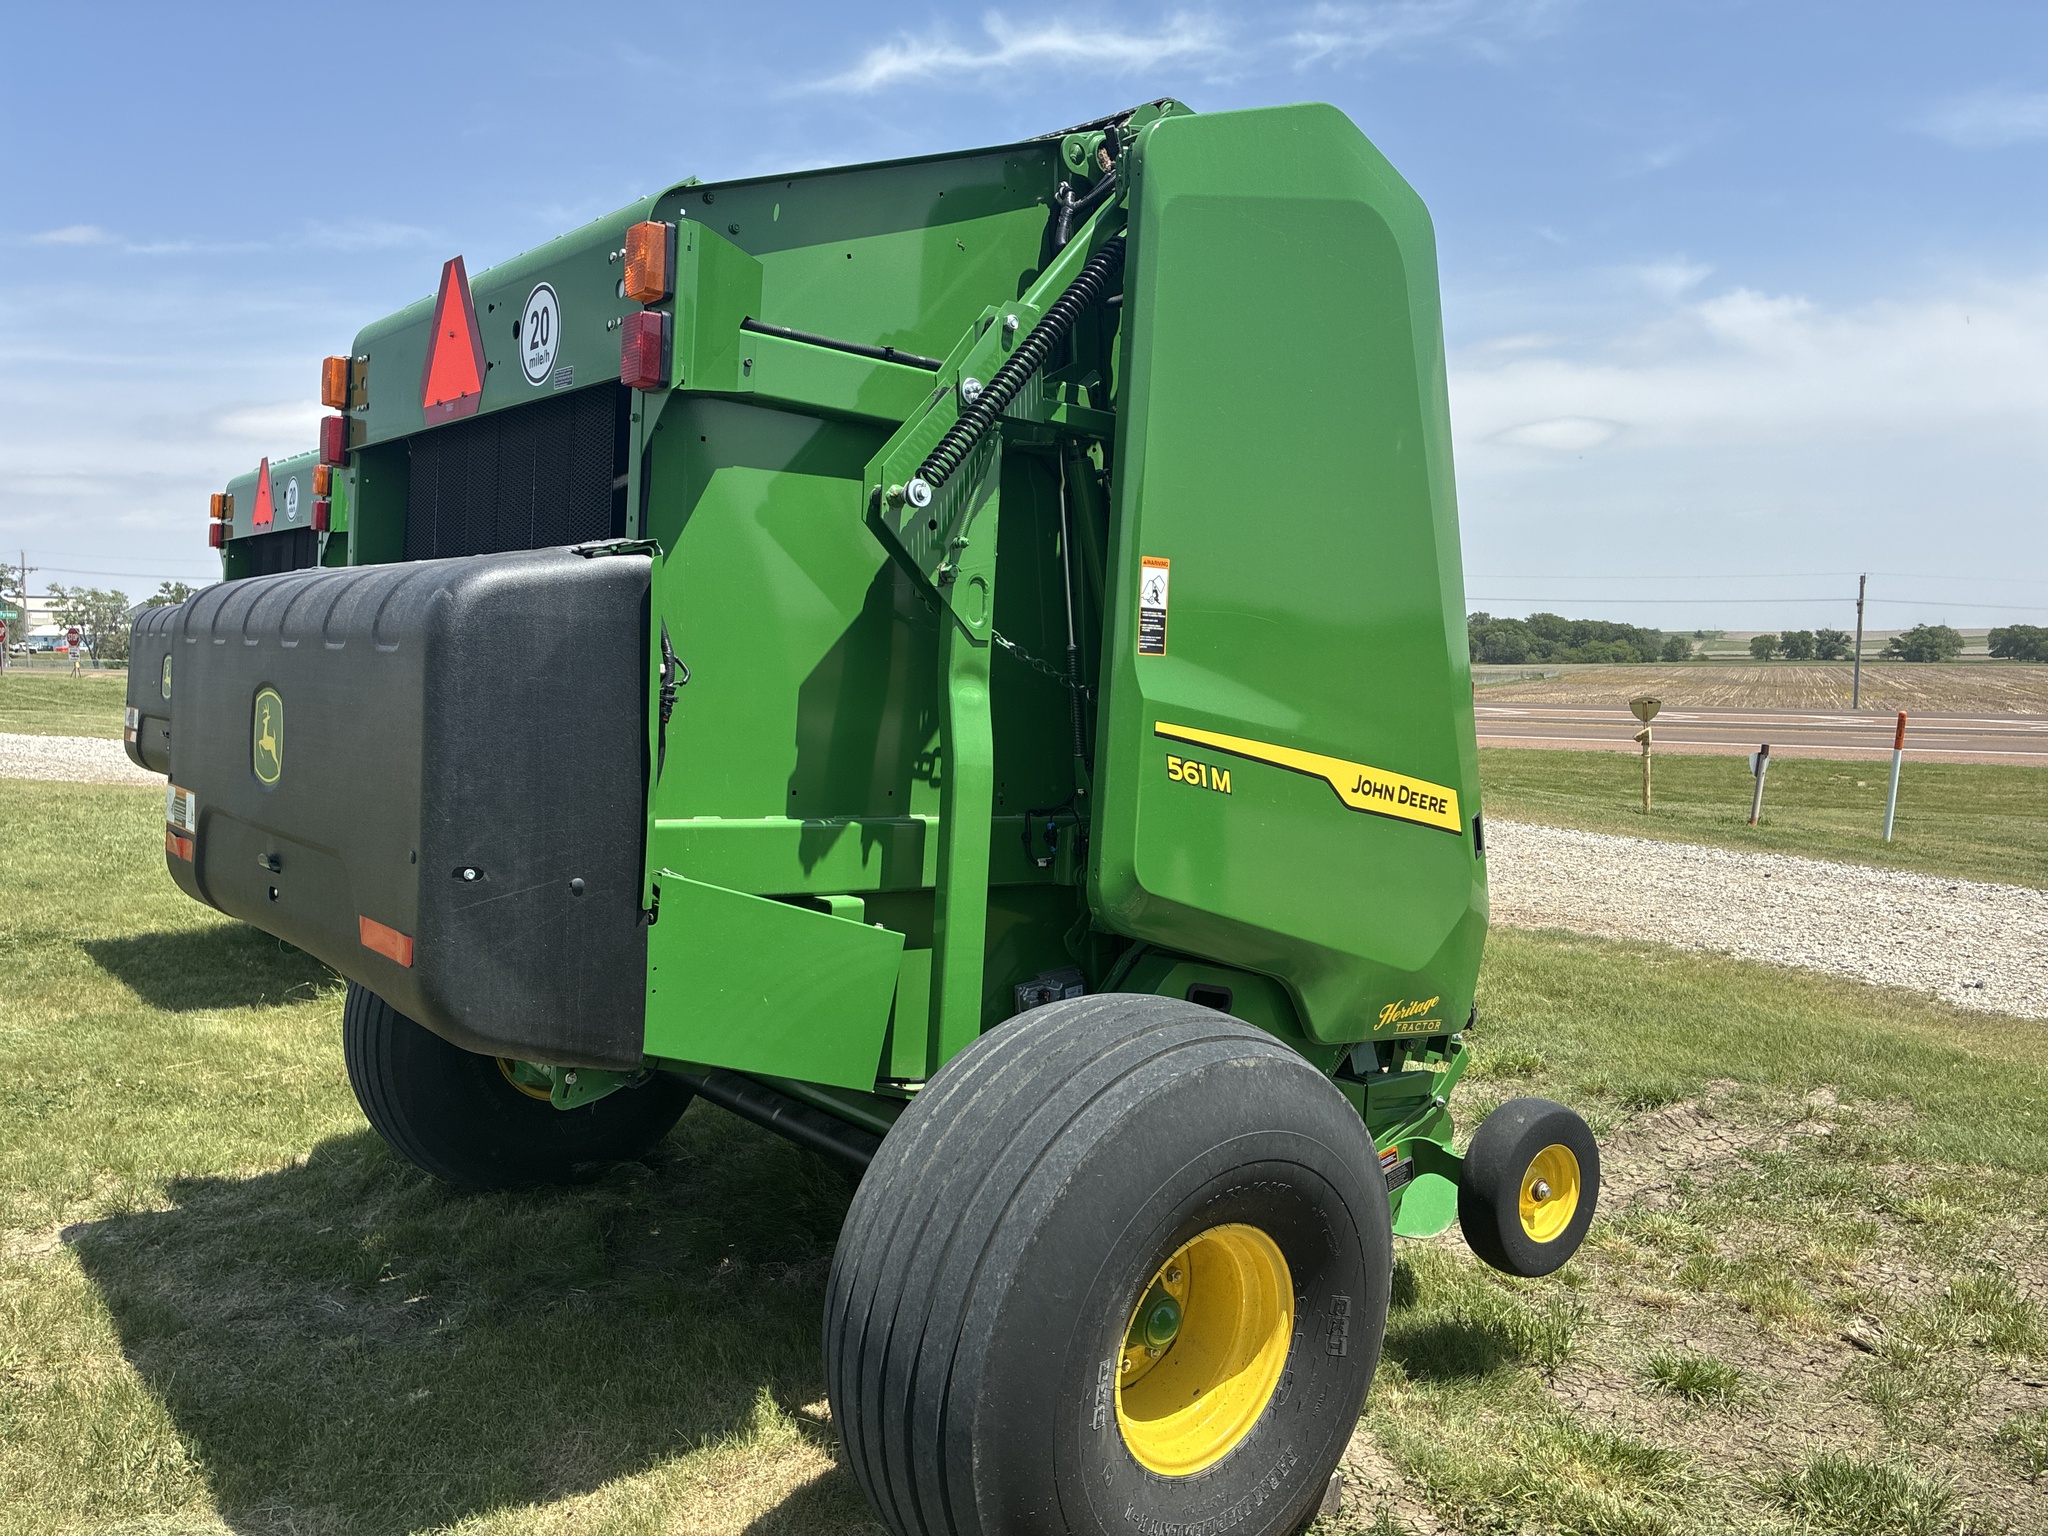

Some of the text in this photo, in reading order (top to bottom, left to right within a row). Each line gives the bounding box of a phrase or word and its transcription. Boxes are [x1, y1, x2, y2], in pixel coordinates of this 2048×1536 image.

[530, 306, 549, 350] 20
[529, 349, 550, 369] mile/h
[1146, 559, 1168, 567] WARNING
[68, 633, 78, 641] STOP
[1351, 774, 1448, 815] JOHN DEERE
[1373, 995, 1440, 1031] Heritage
[1396, 1021, 1441, 1032] TRACTOR
[1251, 1444, 1299, 1507] FARM
